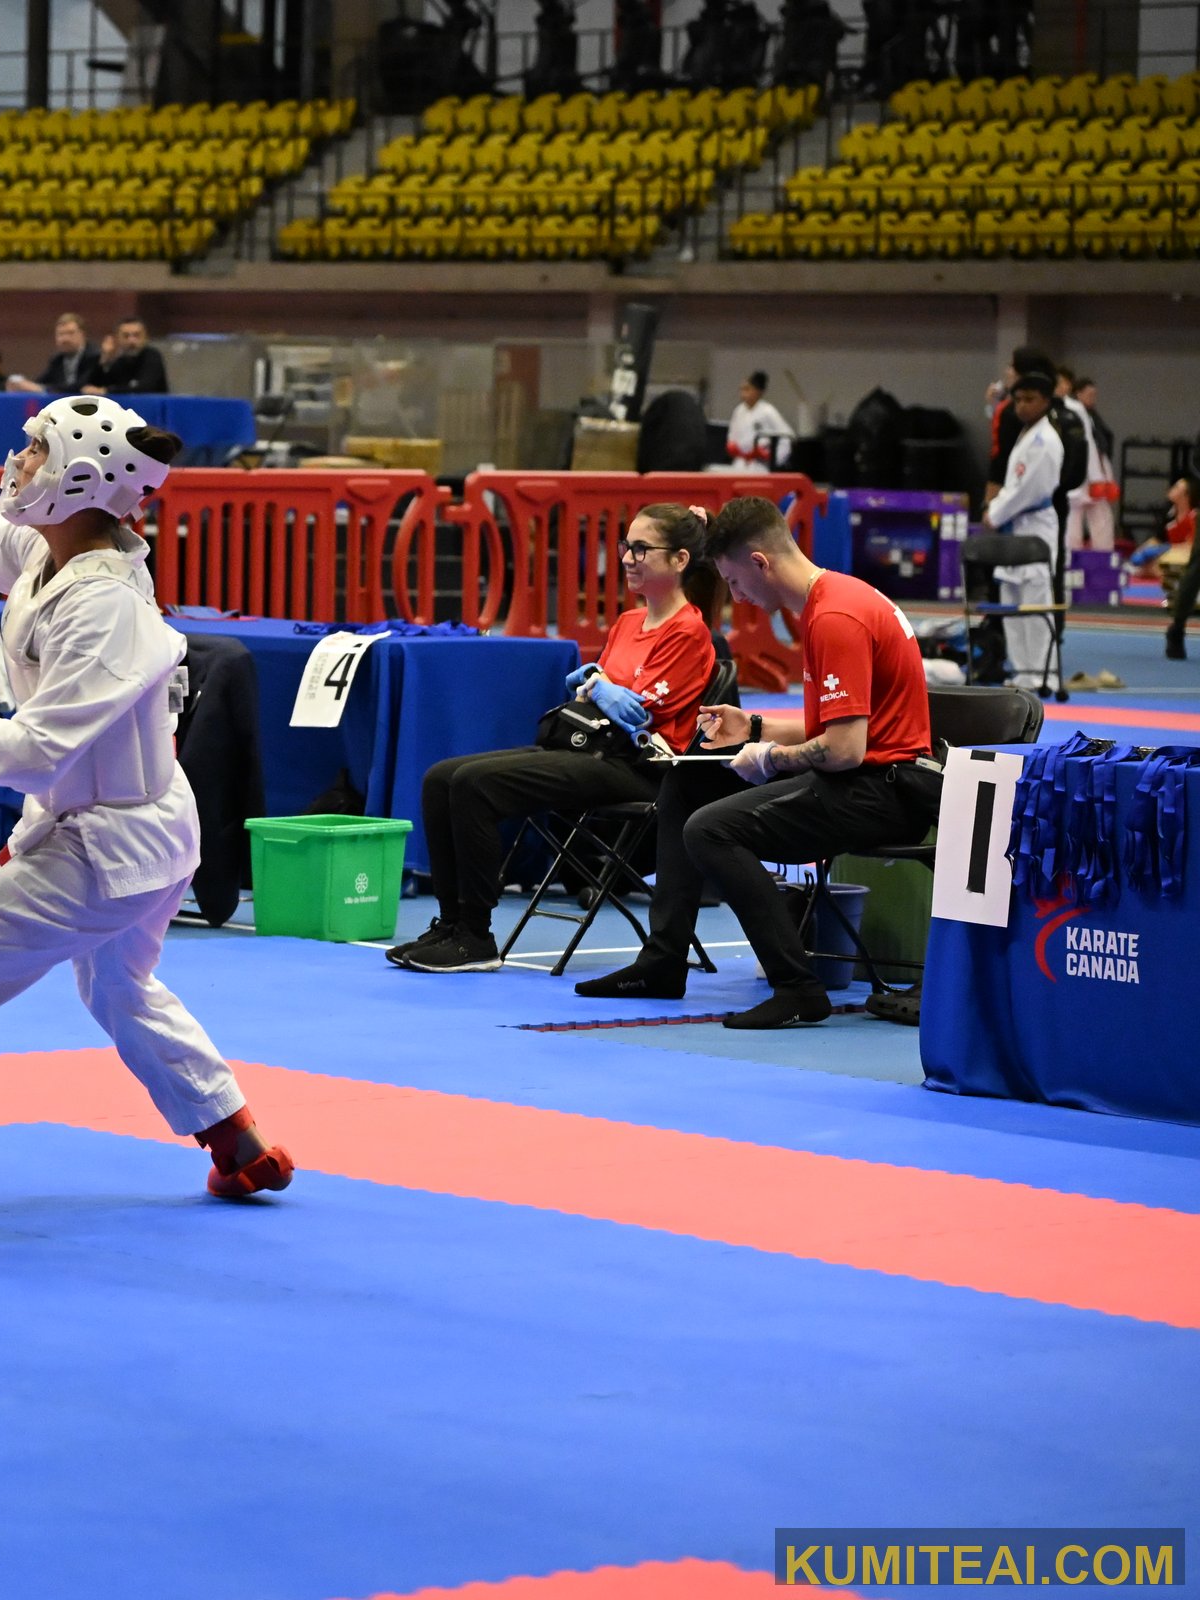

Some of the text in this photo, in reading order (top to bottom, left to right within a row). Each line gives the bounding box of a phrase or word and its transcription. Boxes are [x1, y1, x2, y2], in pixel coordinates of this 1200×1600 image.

[324, 653, 356, 700] 4
[820, 690, 849, 703] MEDICAL
[1066, 926, 1140, 957] KARATE
[1066, 952, 1140, 984] CANADA
